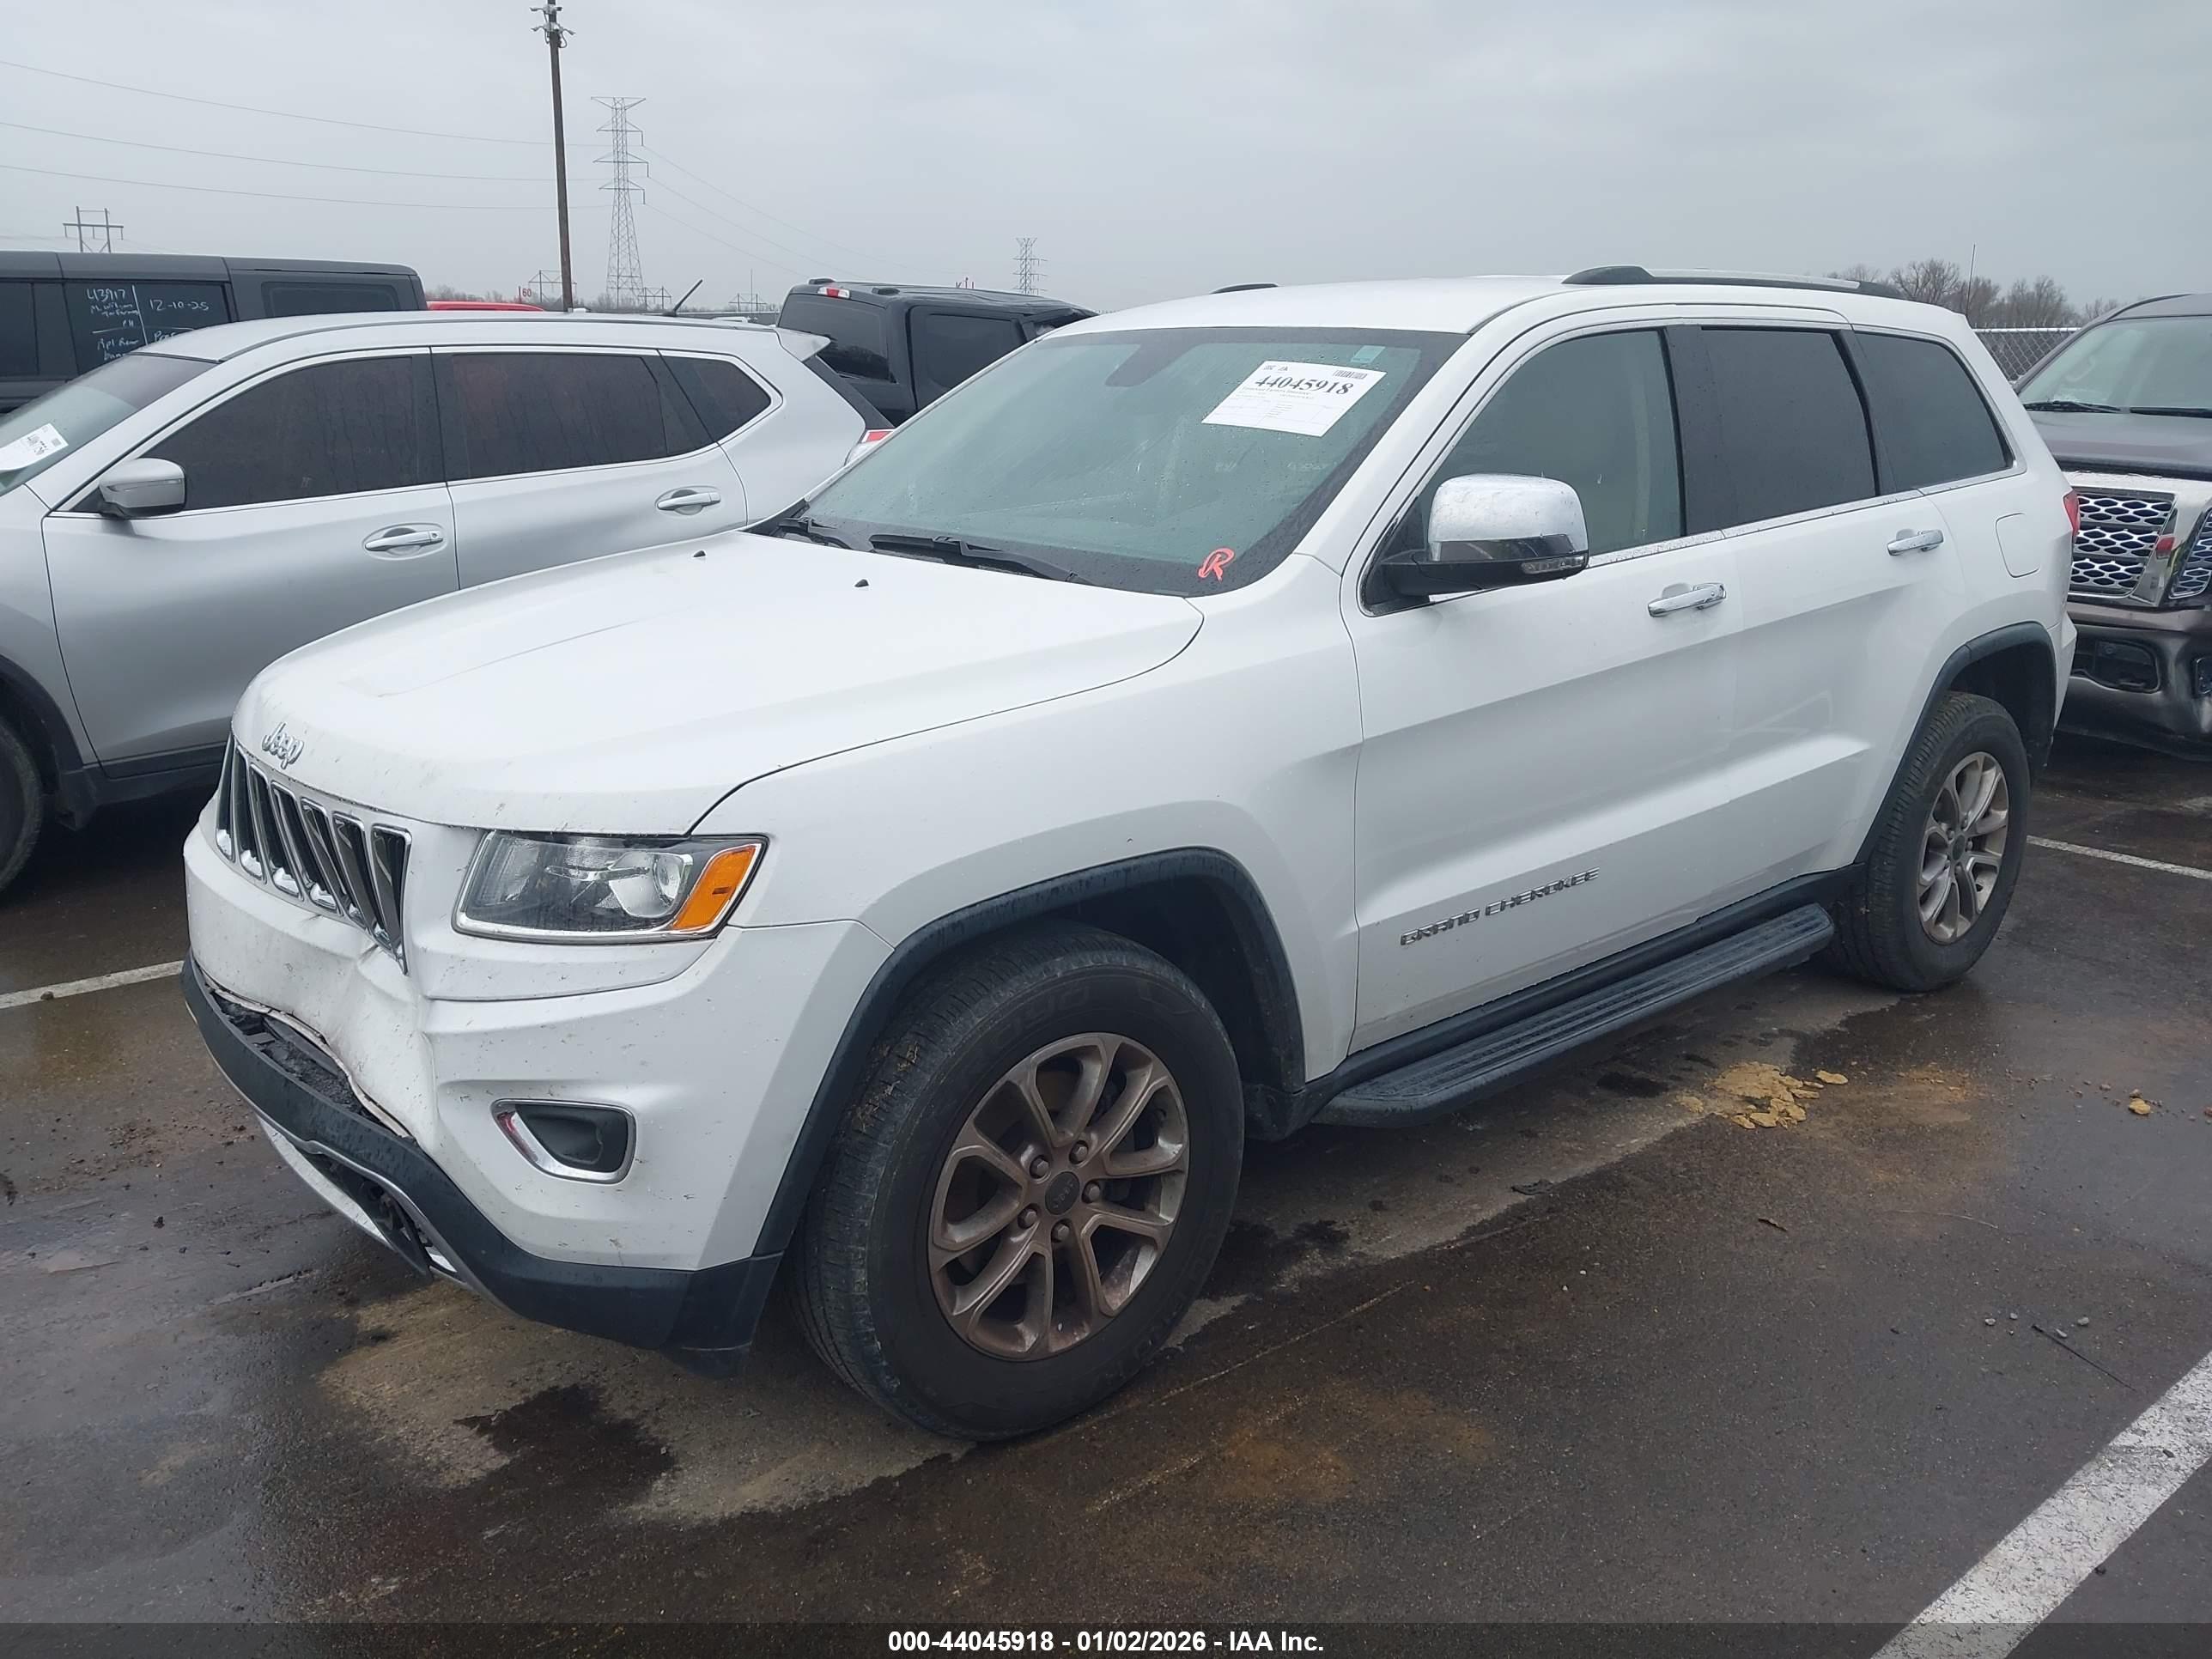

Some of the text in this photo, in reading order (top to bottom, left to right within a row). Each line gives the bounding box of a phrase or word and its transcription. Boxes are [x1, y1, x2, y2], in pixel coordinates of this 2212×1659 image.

[87, 289, 126, 302] 43917
[149, 300, 210, 312] 12-10-25
[1255, 374, 1354, 395] 44045918
[1198, 547, 1235, 584] R
[261, 721, 304, 770] Jeep
[1401, 866, 1600, 945] GRAND CHEROKEE
